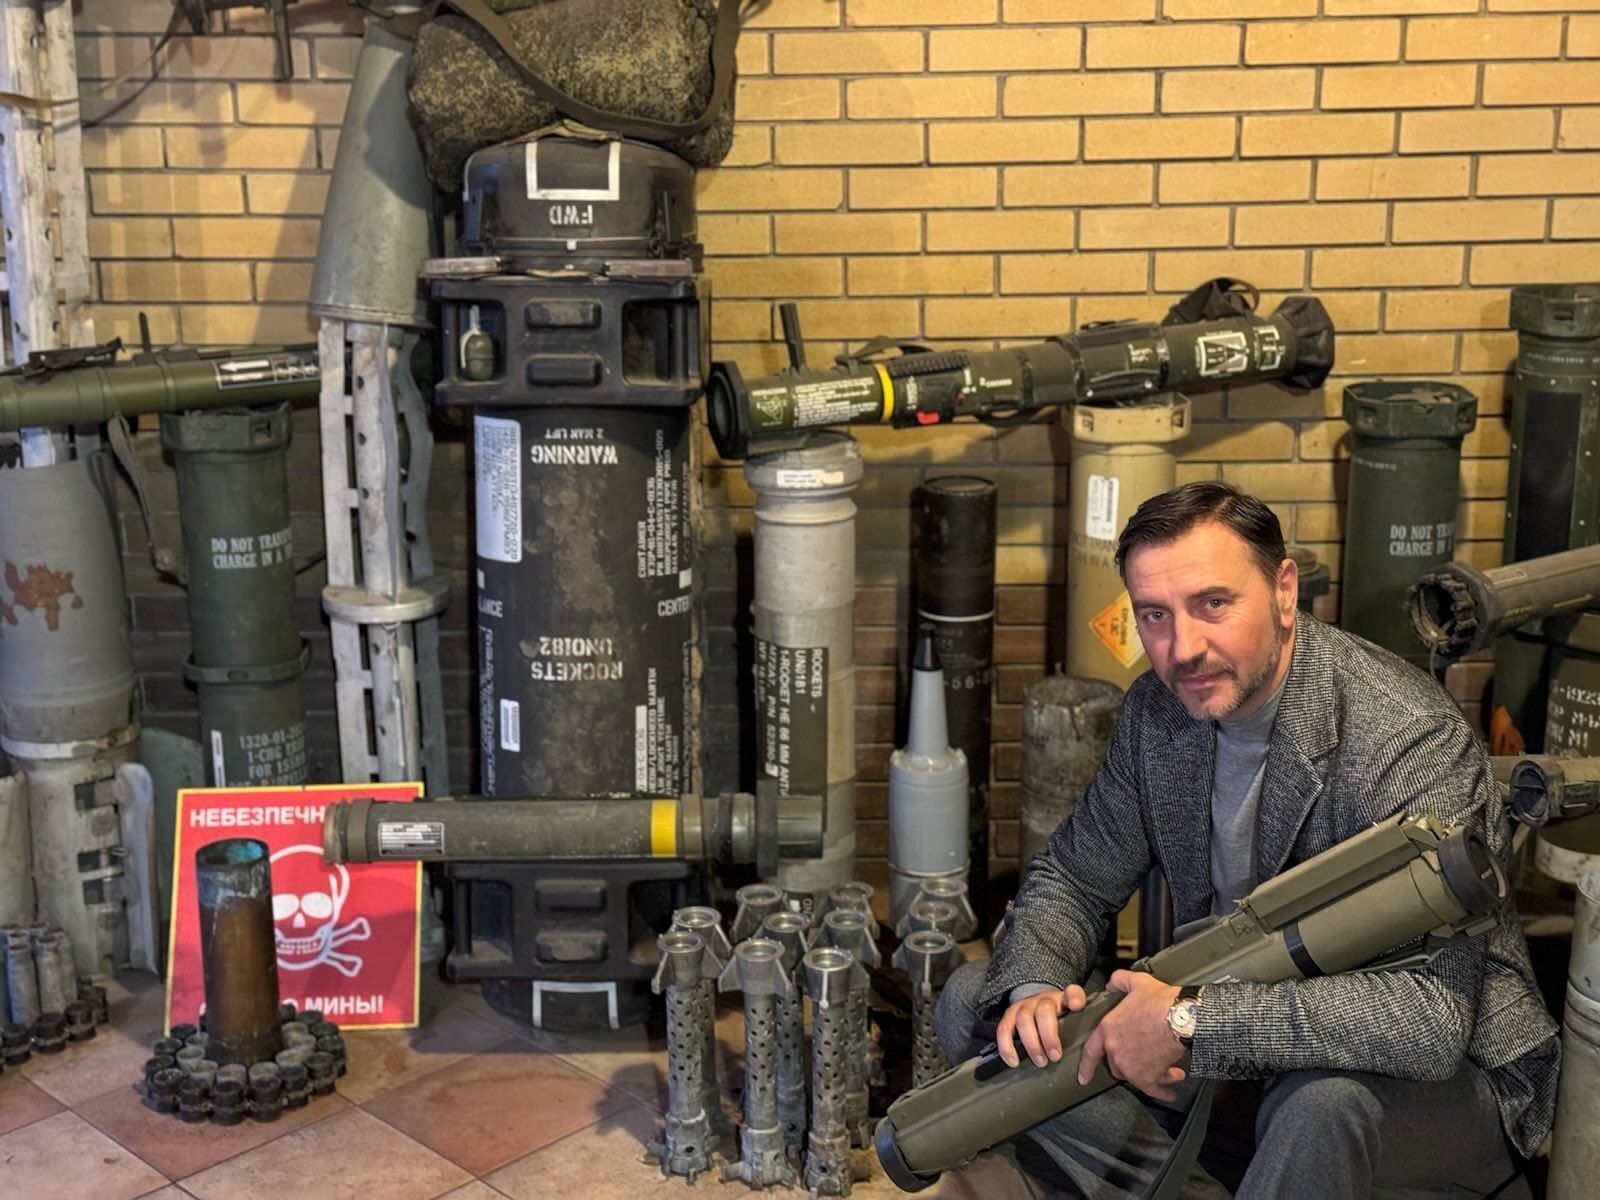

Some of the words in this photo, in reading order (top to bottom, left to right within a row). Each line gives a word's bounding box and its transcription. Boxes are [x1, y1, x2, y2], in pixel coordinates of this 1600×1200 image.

[549, 205, 593, 225] FWD
[544, 428, 568, 439] LIFT
[570, 428, 594, 439] MAN
[531, 445, 618, 465] WARNING
[1390, 525, 1407, 540] DO
[1411, 525, 1433, 540] NOT
[211, 537, 227, 552] DO
[231, 537, 254, 552] NOT
[637, 521, 647, 578] CONTAINER
[1390, 541, 1433, 556] CHARGE
[213, 553, 257, 569] CHARGE
[261, 550, 272, 566] IN
[530, 661, 623, 680] ROCKETS
[779, 649, 790, 704] 1-ROCKET
[795, 649, 806, 695] UN0181
[811, 648, 823, 698] ROCKETS
[648, 667, 657, 706] MARTIN
[657, 697, 666, 742] VENTURE
[779, 707, 790, 724] HE
[779, 727, 790, 741] 66
[779, 744, 790, 763] MM
[248, 763, 272, 779] FOR
[190, 806, 325, 828] НЕБЕЗПЕЧН
